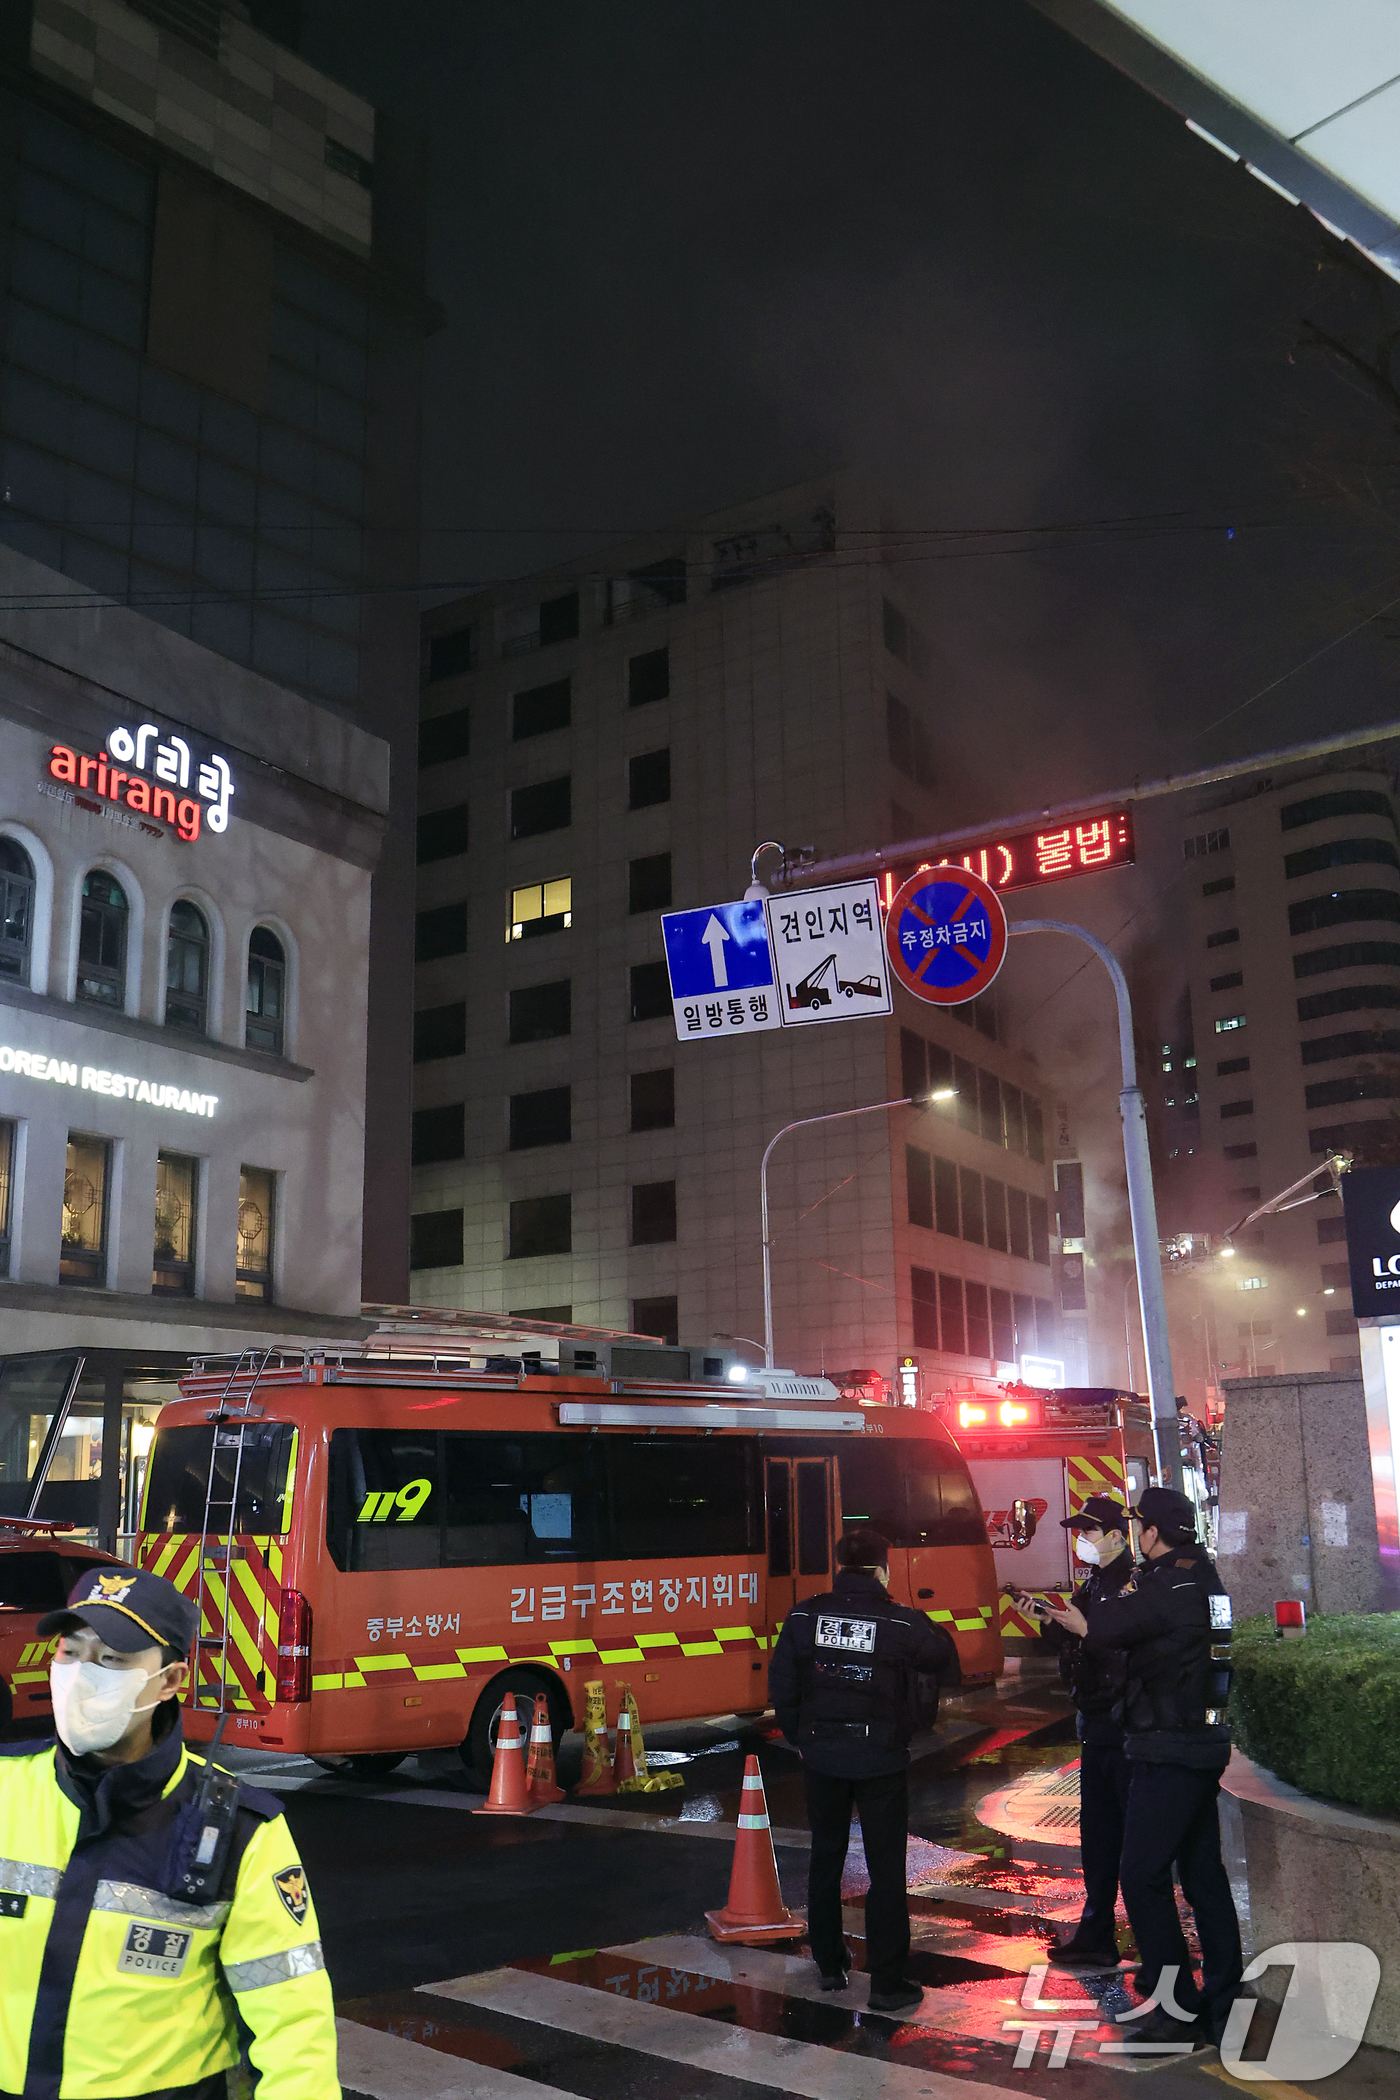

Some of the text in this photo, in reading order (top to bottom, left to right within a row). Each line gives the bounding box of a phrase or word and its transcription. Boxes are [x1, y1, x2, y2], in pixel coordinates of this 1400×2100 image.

[49, 745, 201, 842] arirang
[108, 723, 234, 833] 아리랑
[780, 897, 875, 944] 견인지역
[901, 919, 987, 951] 주정차금지
[683, 994, 769, 1031] 일방통행
[81, 1066, 219, 1118] RESTAURANT
[356, 1478, 432, 1522] 119
[510, 1572, 759, 1624] 긴급구조현장지휘대
[366, 1613, 461, 1642] 중부소방서
[124, 1955, 178, 1972] POLICE
[132, 1925, 185, 1958] 경찰
